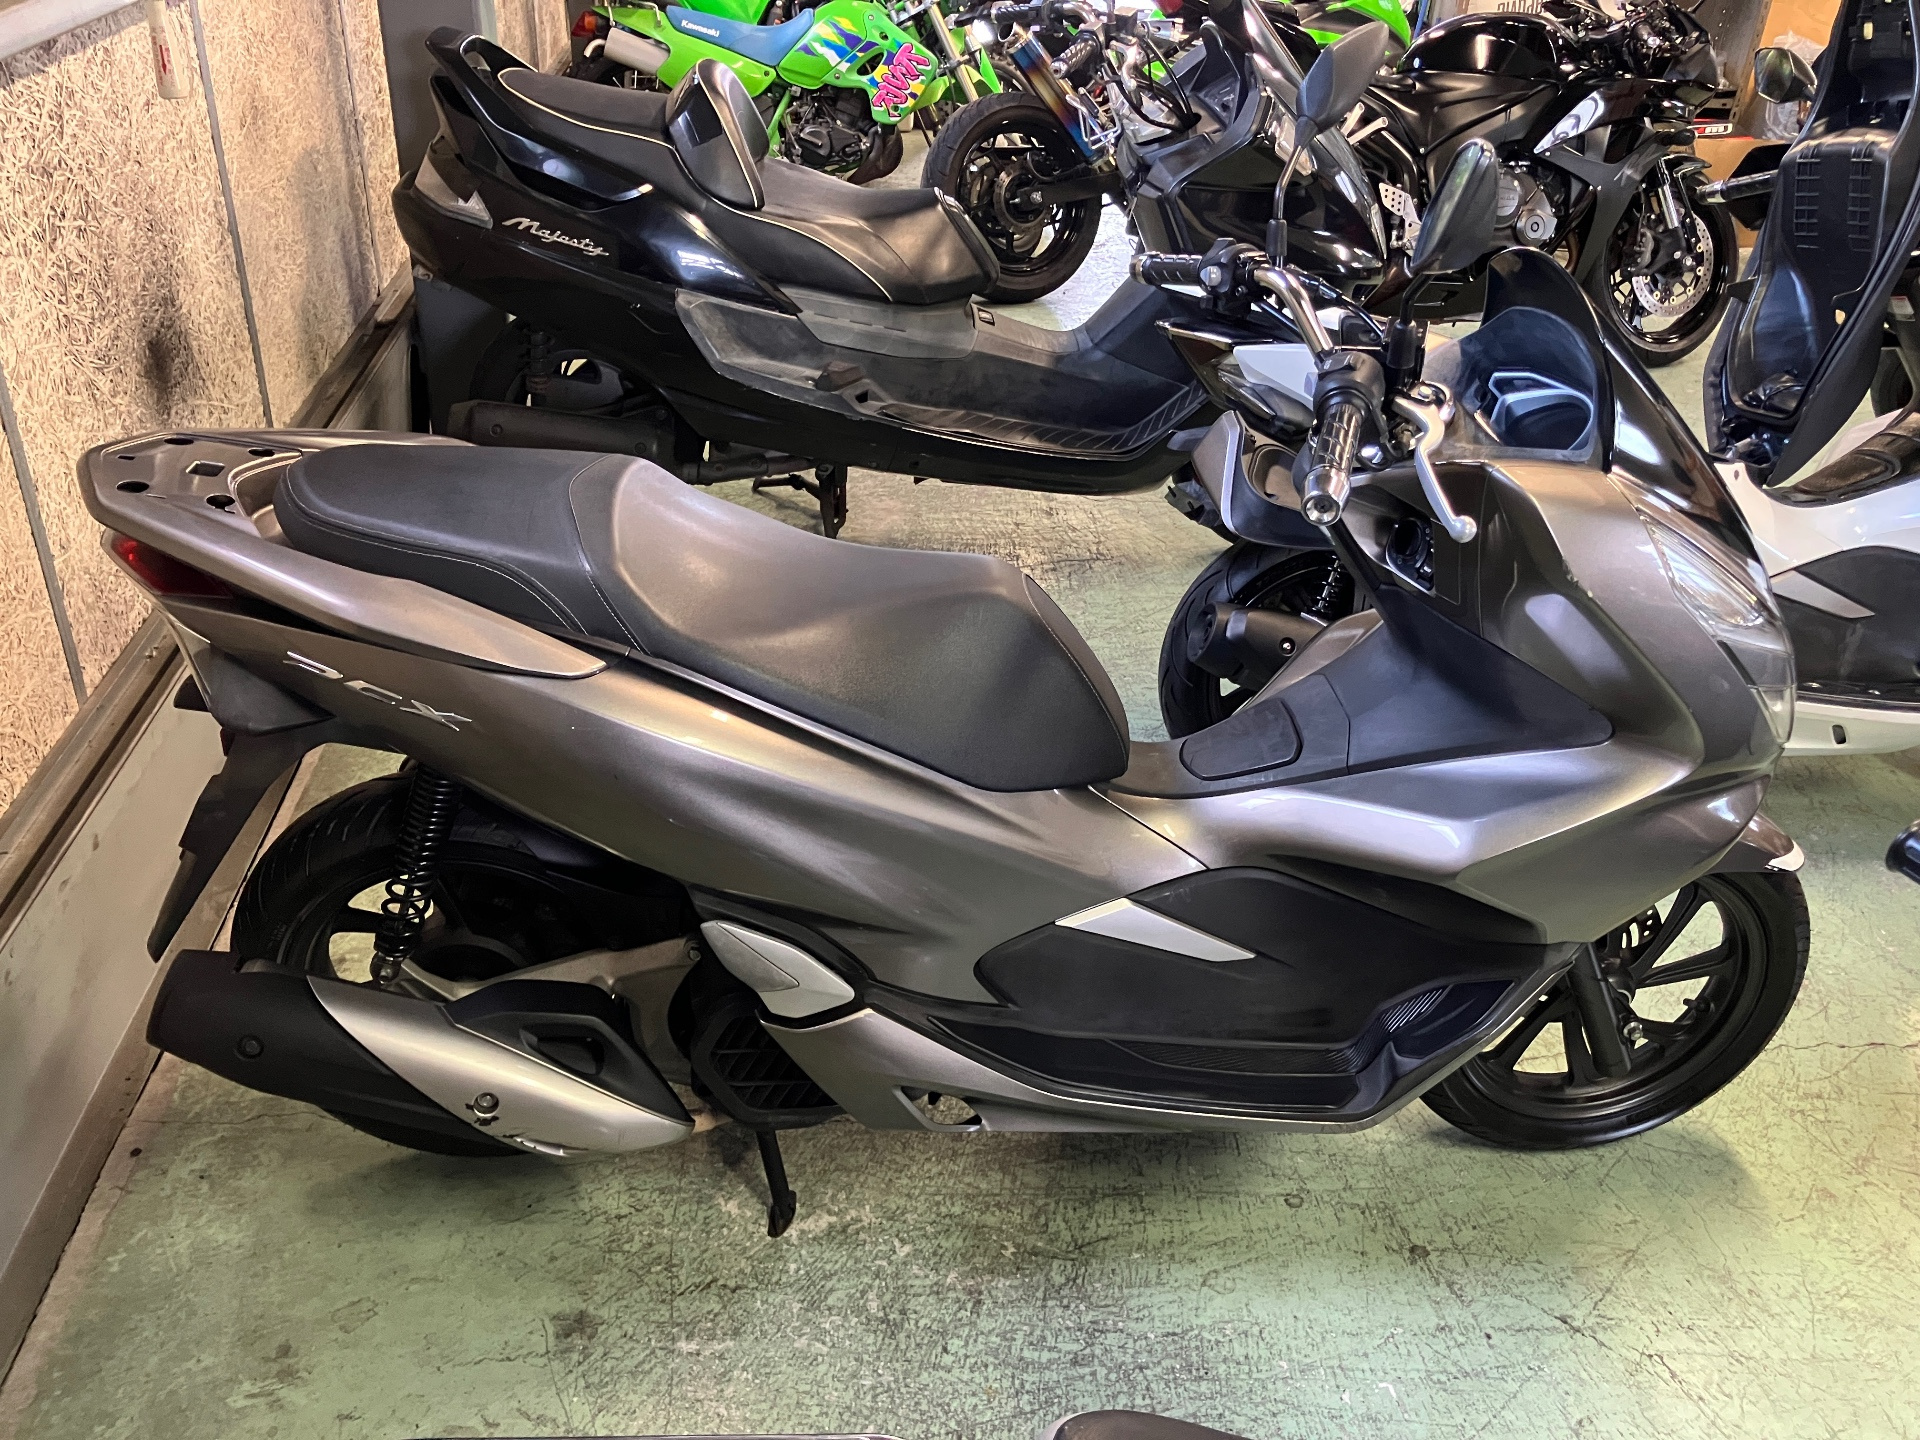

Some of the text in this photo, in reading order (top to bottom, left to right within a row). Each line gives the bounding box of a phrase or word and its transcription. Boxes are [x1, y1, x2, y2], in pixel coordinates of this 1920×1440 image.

[681, 19, 720, 38] Kawasaki
[501, 217, 610, 256] Majesty
[283, 651, 472, 731] PCX
